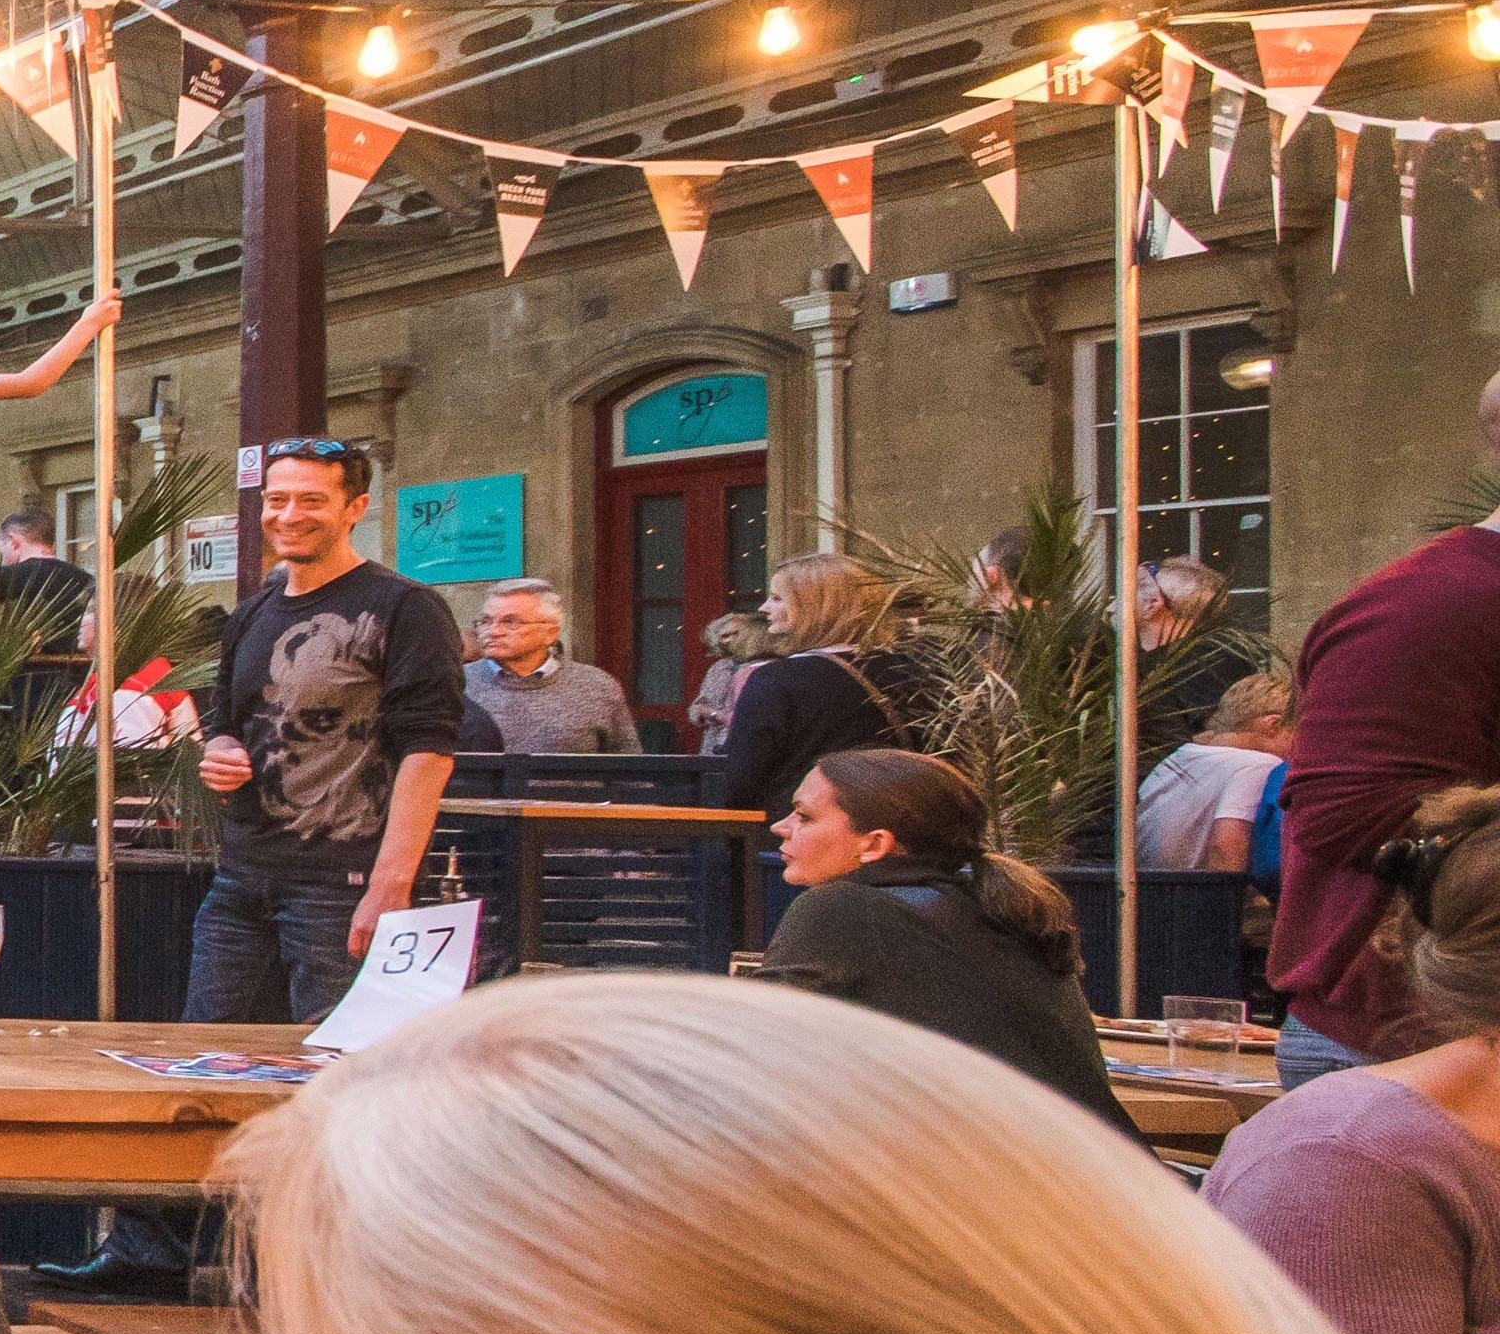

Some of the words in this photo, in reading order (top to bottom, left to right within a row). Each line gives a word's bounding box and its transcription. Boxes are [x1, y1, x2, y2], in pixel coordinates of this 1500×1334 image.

[188, 75, 225, 98] Function
[201, 71, 220, 85] Bath
[188, 86, 218, 105] Rooms
[190, 541, 212, 571] NO
[382, 926, 456, 975] 37
